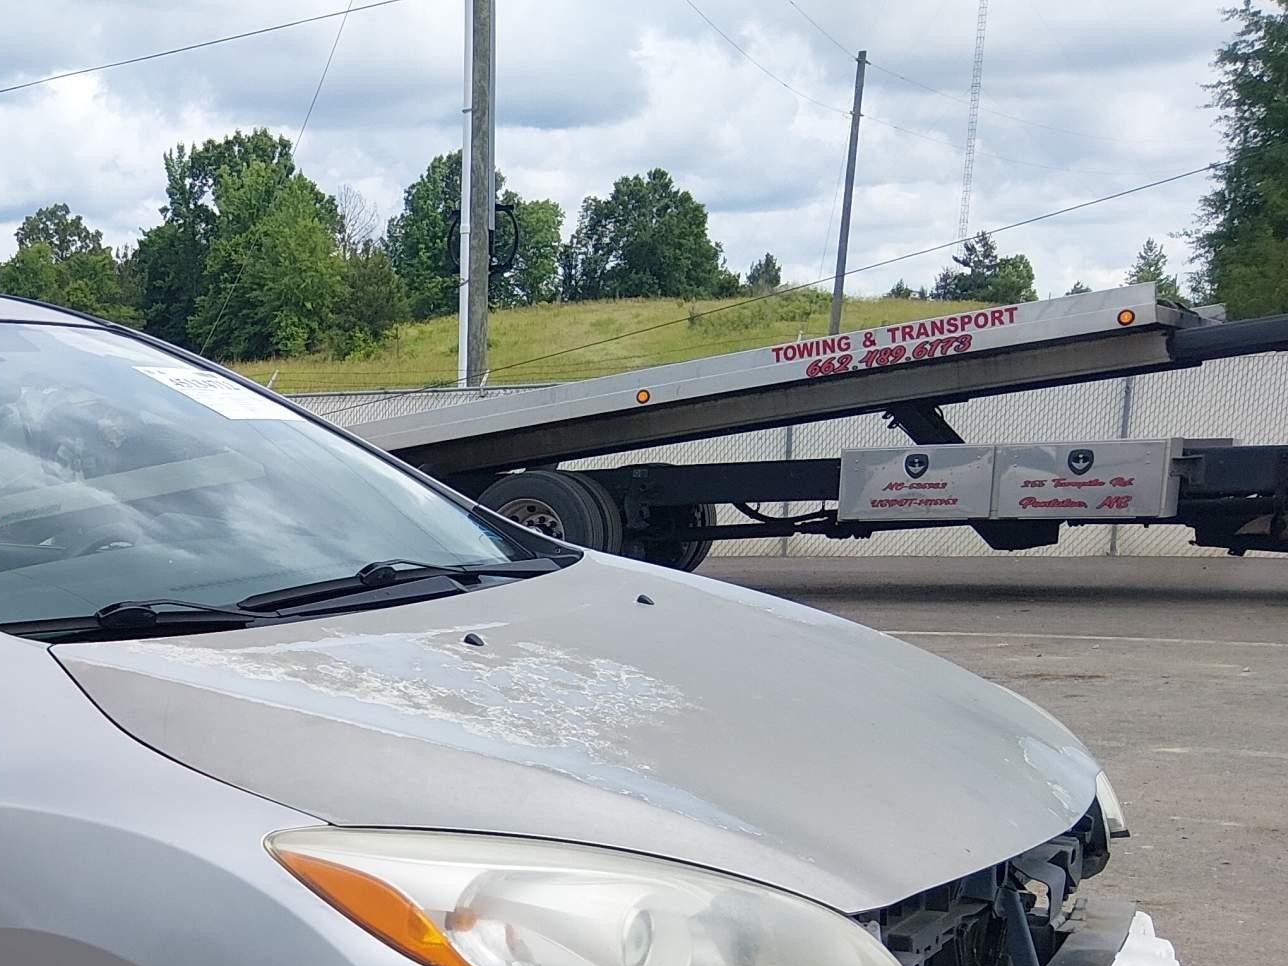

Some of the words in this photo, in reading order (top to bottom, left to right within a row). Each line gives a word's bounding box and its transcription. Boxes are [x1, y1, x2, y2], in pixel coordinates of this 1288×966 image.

[772, 335, 851, 363] TOWING
[862, 331, 877, 349] &
[887, 306, 1019, 344] TRANSPORT
[805, 334, 973, 378] 662.489.6173
